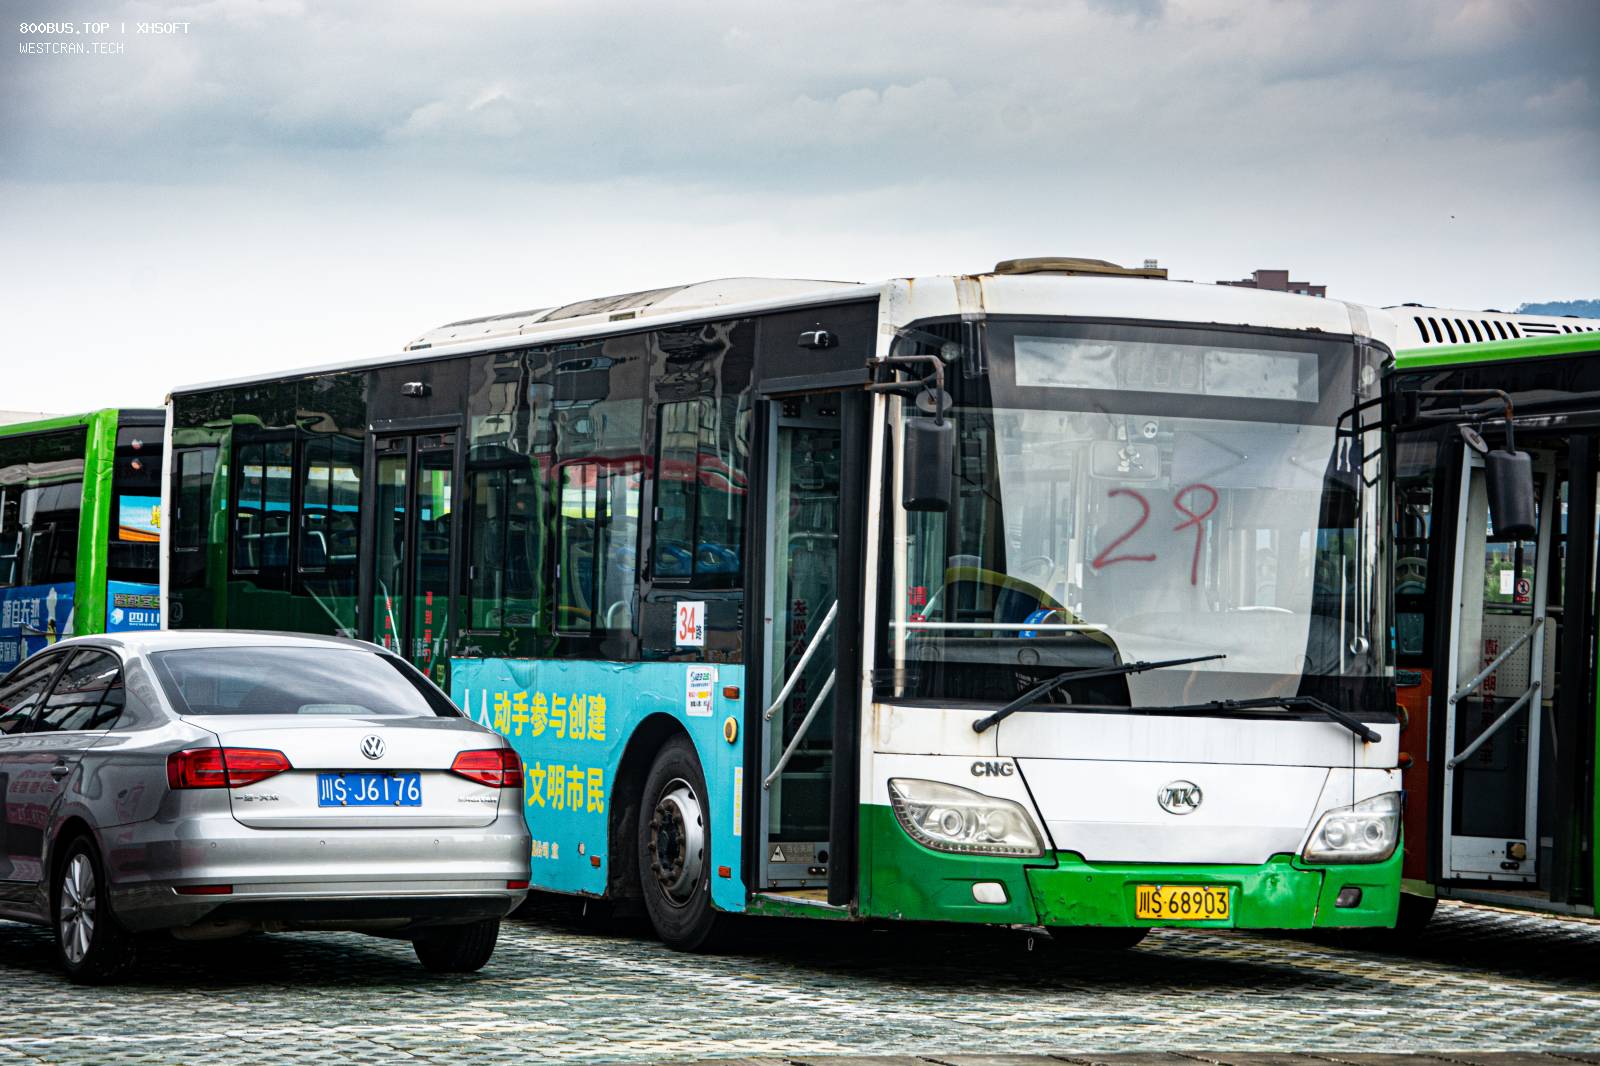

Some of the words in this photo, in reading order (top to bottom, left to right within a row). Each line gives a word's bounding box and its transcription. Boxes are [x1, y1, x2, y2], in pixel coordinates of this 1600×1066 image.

[1092, 484, 1219, 585] 29
[679, 606, 696, 641] 34
[971, 761, 1014, 777] CNG
[322, 777, 420, 801] 川S·J6176
[523, 761, 604, 814] 文明市民
[1139, 891, 1227, 915] 川S·68903
